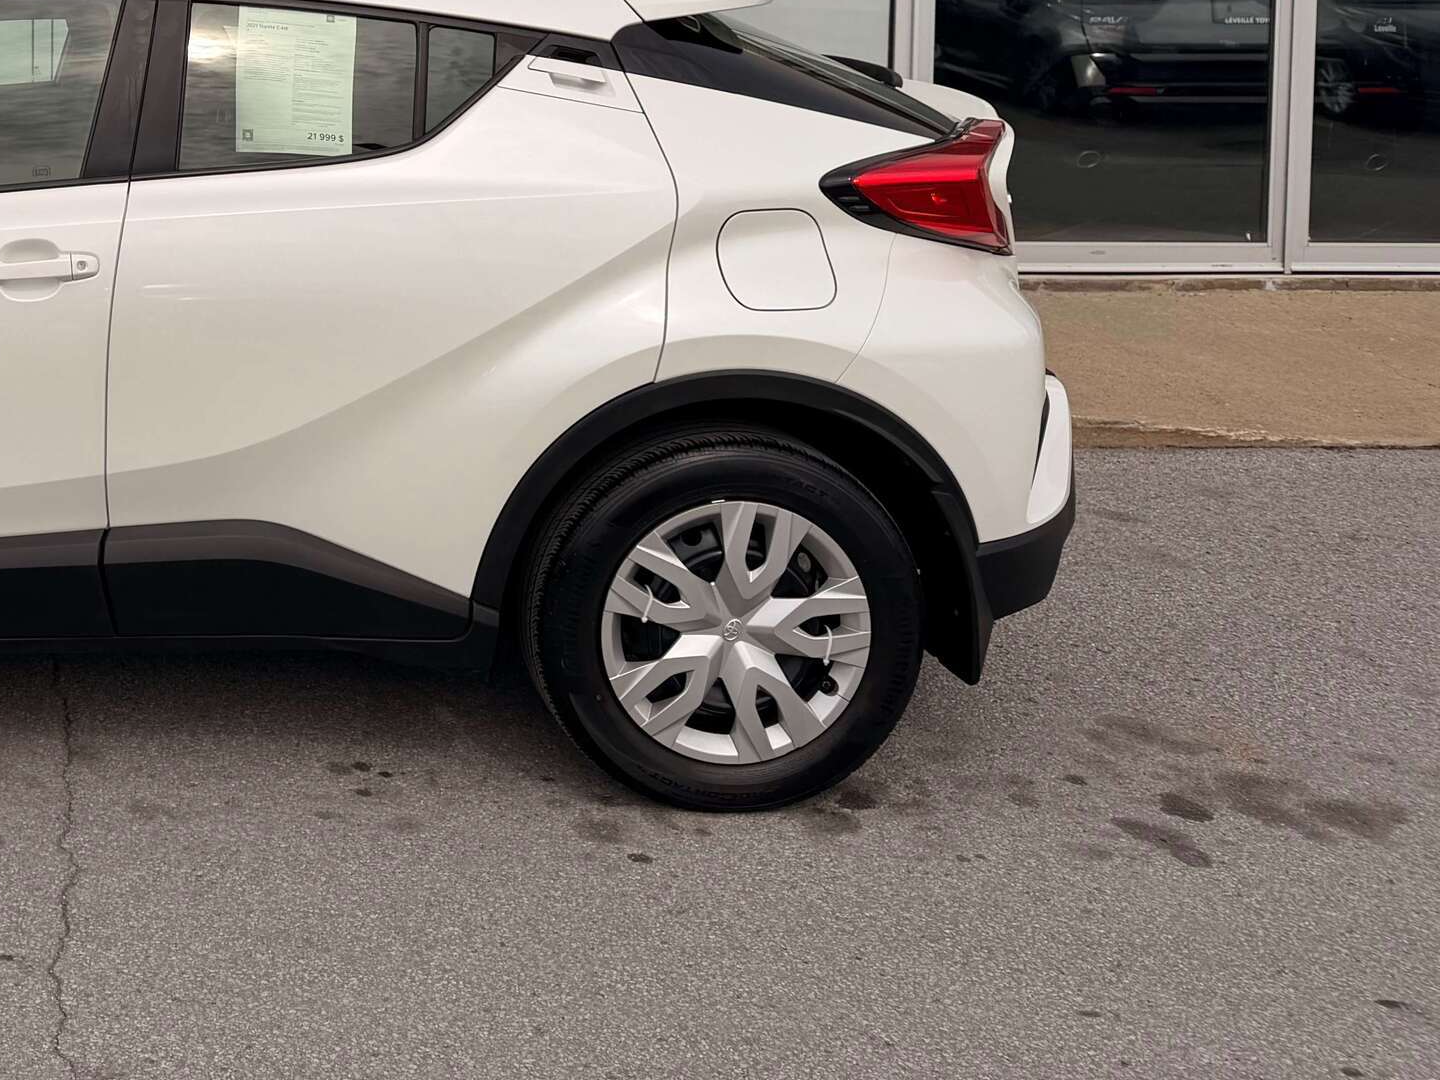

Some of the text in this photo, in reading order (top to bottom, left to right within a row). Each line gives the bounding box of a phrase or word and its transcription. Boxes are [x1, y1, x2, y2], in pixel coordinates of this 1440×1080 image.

[307, 132, 345, 143] 21 999 $
